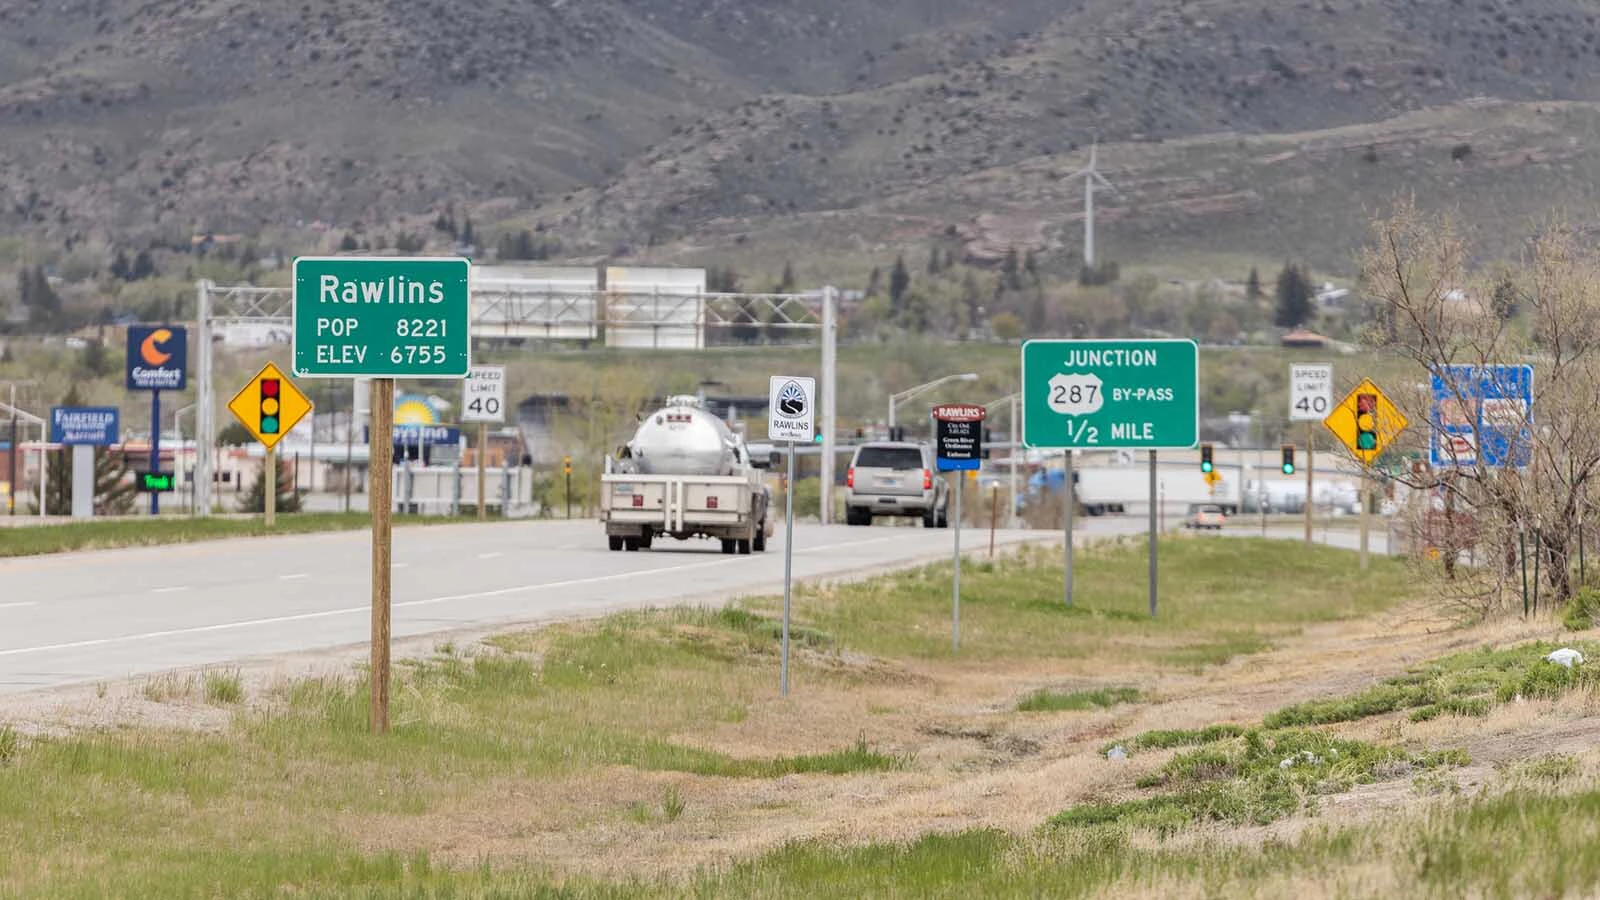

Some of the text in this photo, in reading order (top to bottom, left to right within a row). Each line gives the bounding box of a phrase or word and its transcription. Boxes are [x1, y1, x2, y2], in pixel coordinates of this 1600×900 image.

[320, 274, 444, 304] Rawlins
[317, 318, 446, 337] POP 8221
[317, 345, 446, 364] ELEV 6755
[1064, 350, 1157, 367] JUNCTION
[132, 366, 181, 380] Comfort
[1295, 369, 1328, 378] SPEED
[470, 384, 497, 392] LIMIT
[1053, 385, 1098, 404] 287
[1112, 388, 1174, 401] BY-PASS
[468, 397, 500, 414] 40
[938, 408, 979, 417] RAWLINS
[1295, 396, 1327, 413] 40
[55, 409, 114, 424] FAIRFIELD
[773, 420, 809, 430] RAWLINS
[1066, 419, 1154, 443] 1/2 MILE
